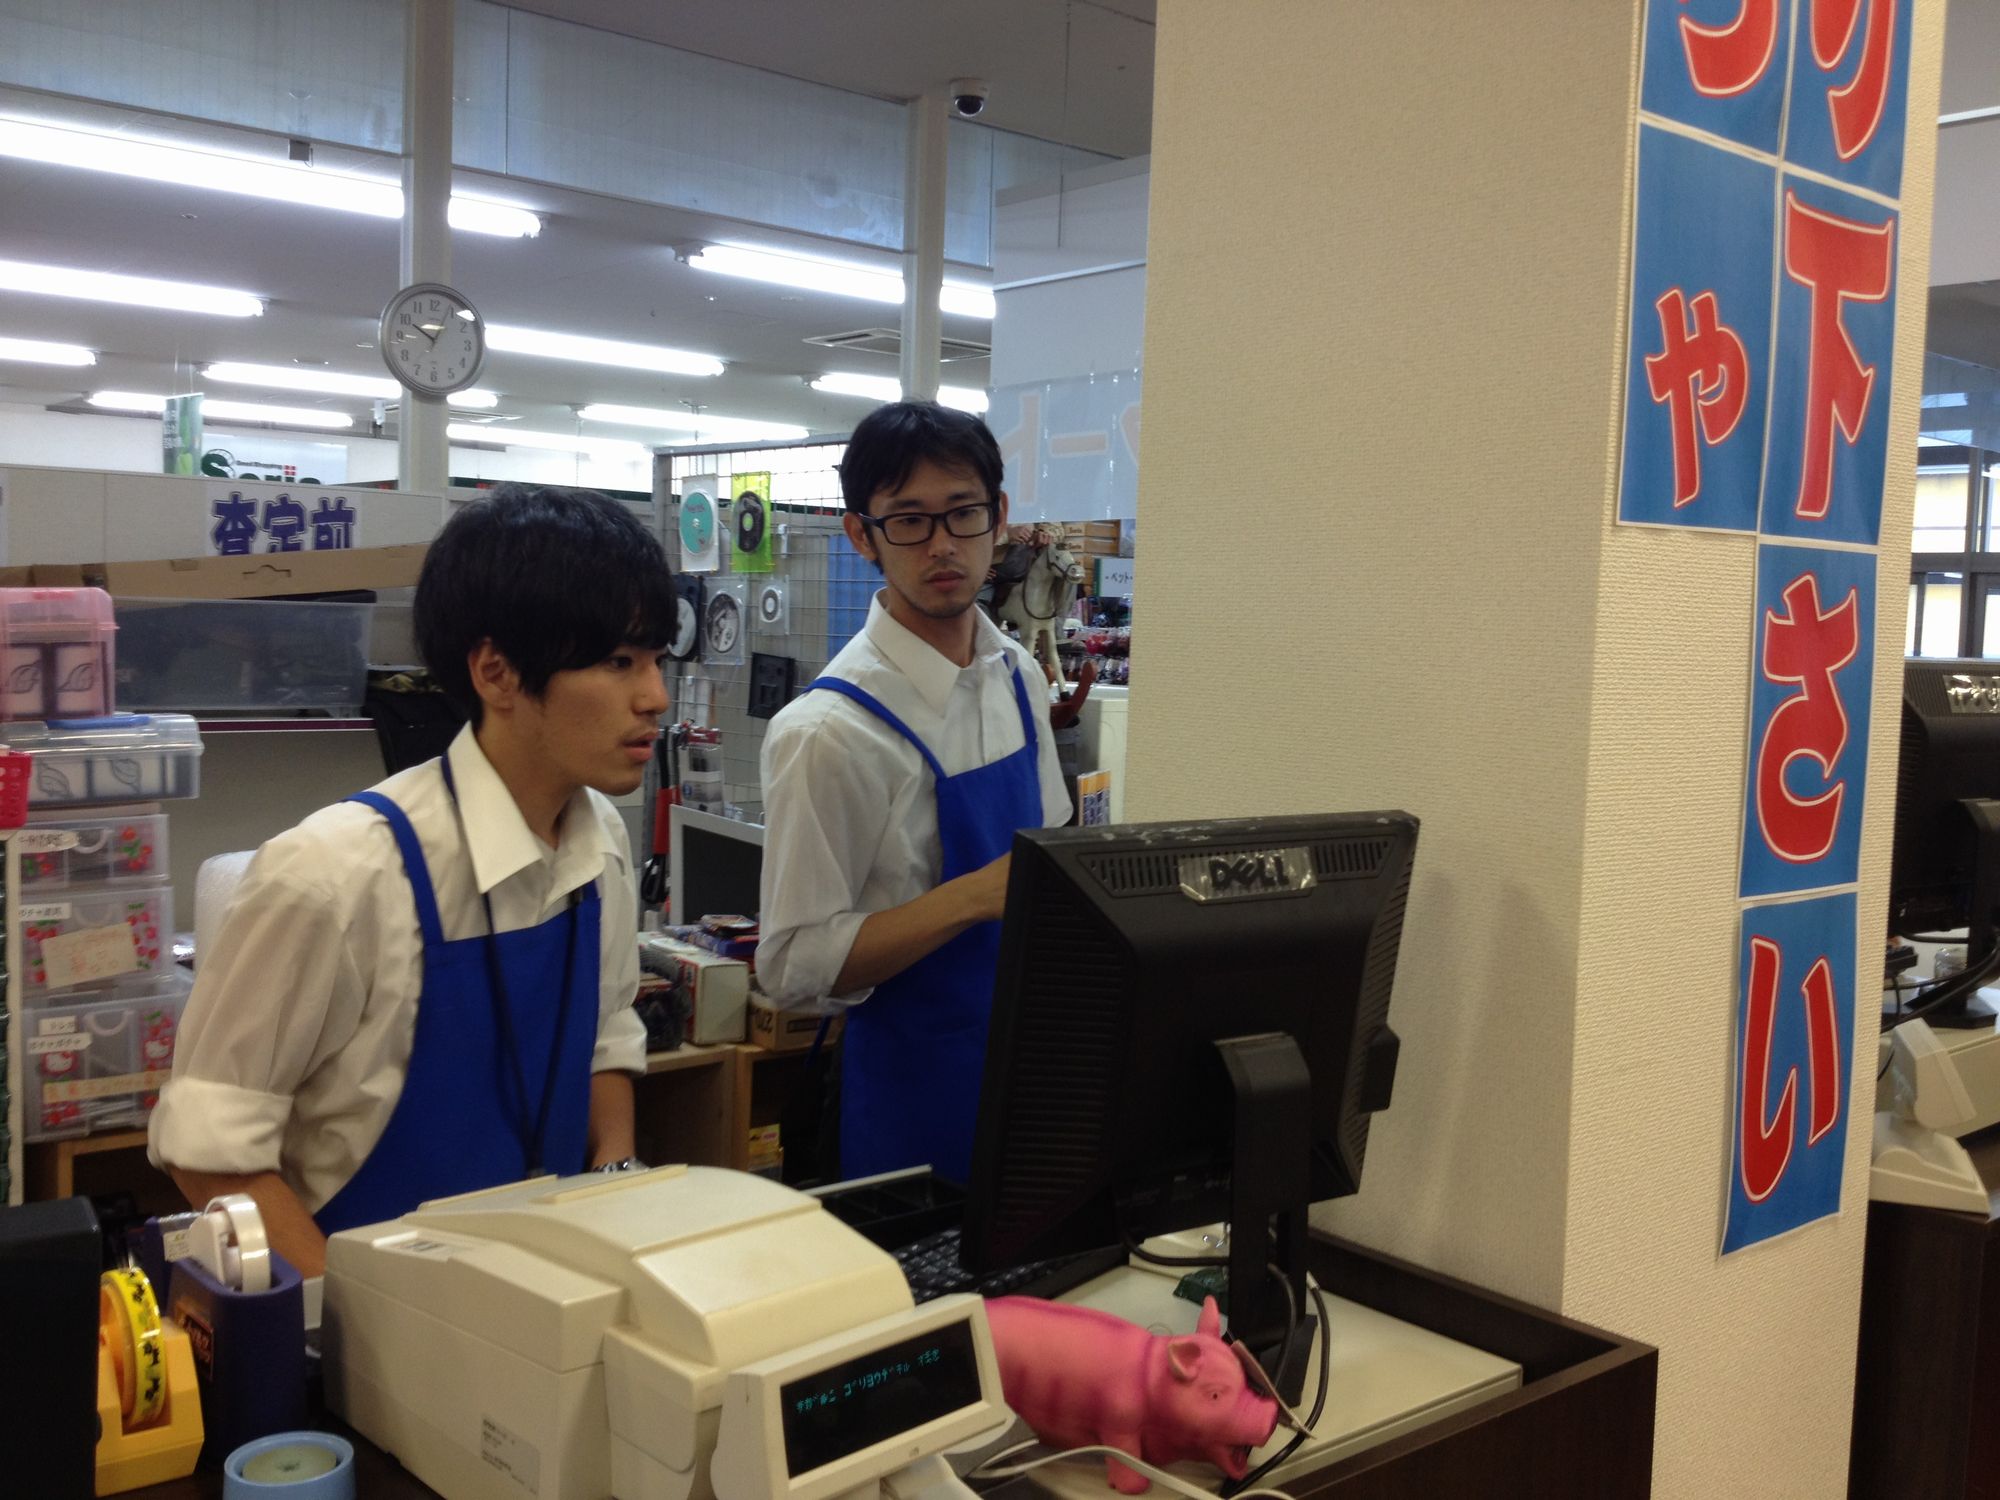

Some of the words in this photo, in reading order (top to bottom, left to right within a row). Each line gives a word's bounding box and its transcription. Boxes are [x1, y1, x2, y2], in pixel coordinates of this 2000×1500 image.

[413, 301, 422, 314] 11
[429, 299, 440, 312] 12
[449, 306, 455, 319] 1
[400, 313, 411, 325] 10
[459, 322, 468, 334] 2
[396, 331, 404, 340] 9
[464, 340, 472, 352] 3
[400, 349, 409, 361] 8
[459, 357, 466, 369] 4
[413, 364, 421, 376] 7
[448, 368, 456, 379] 5
[430, 371, 437, 382] 6
[1209, 854, 1290, 890] DELL
